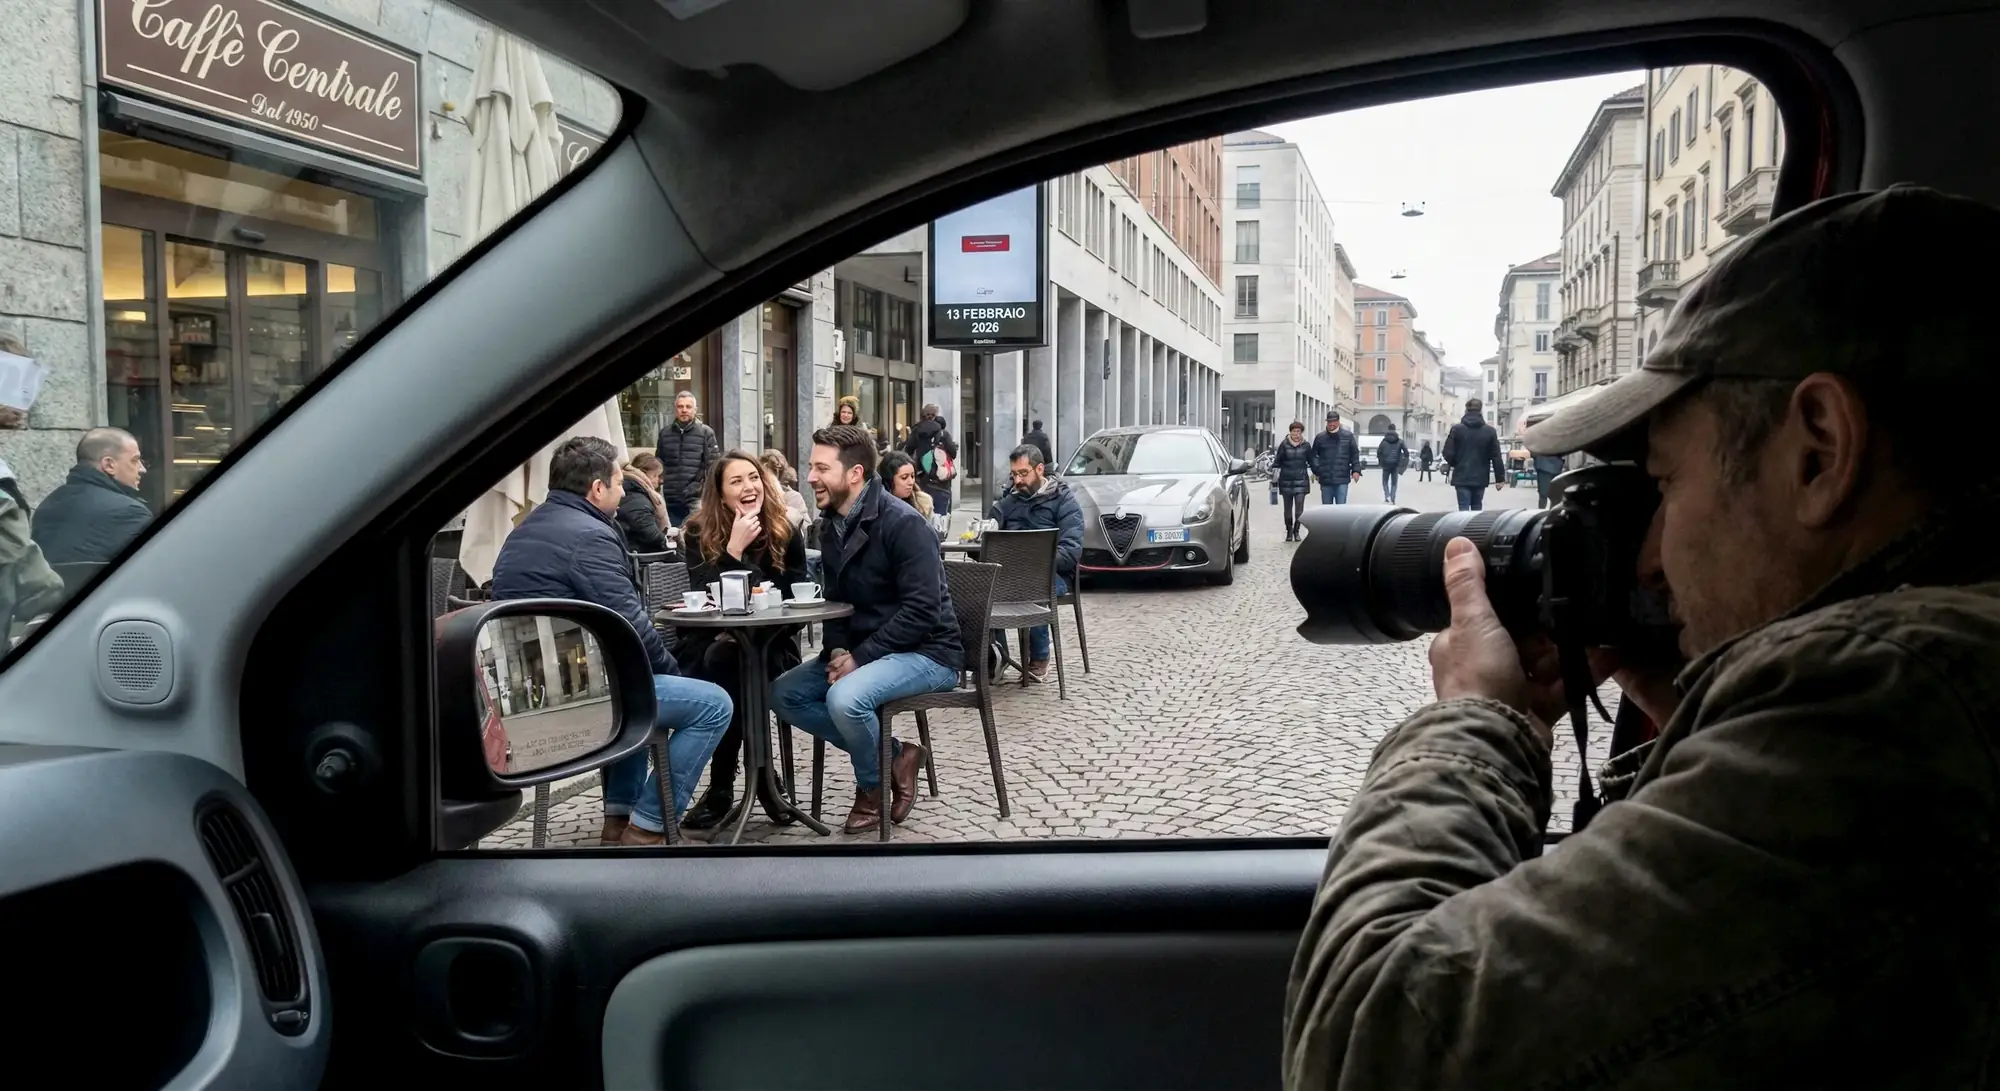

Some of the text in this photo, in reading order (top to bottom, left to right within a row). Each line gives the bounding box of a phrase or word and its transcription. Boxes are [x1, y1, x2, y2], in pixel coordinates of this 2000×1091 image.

[257, 20, 402, 121] Centrale
[251, 93, 319, 131] Dal 1950
[946, 307, 1026, 320] 13 FEBBRAIO
[971, 321, 1000, 333] 2026
